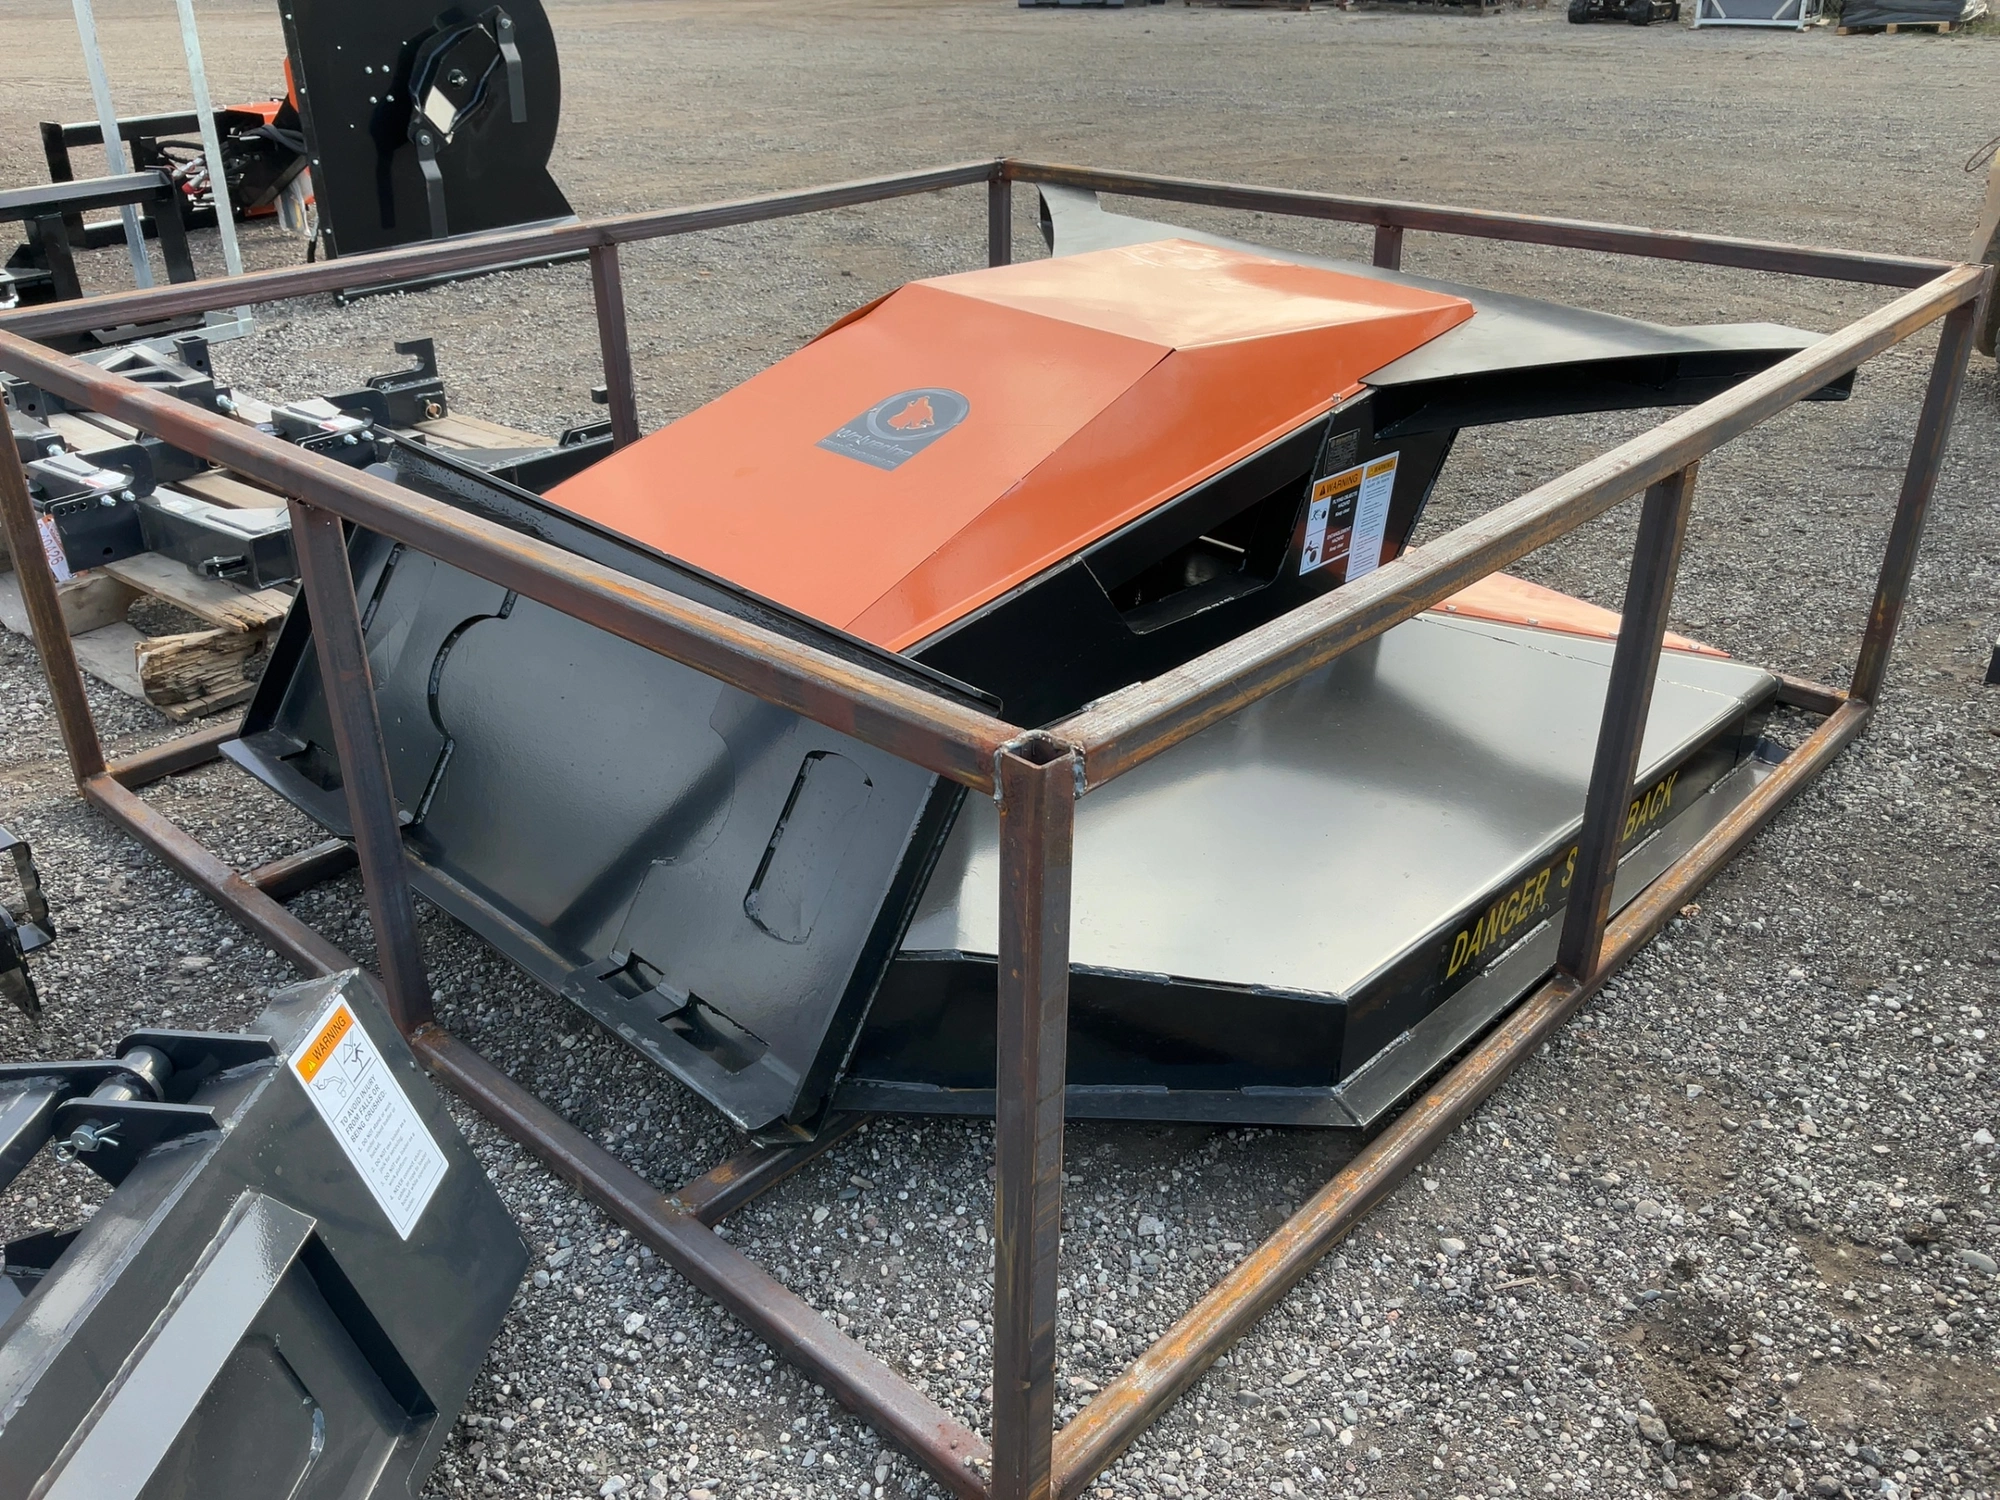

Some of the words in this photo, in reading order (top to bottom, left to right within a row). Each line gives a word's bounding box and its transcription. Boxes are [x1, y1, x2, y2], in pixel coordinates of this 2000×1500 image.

[1326, 473, 1358, 492] WARNING
[1622, 771, 1679, 841] BACK
[1446, 868, 1550, 979] DANGER
[312, 1016, 347, 1061] WARNING
[340, 1116, 349, 1127] TO
[347, 1096, 362, 1119] AVOID
[360, 1074, 376, 1099] INJURY
[345, 1113, 361, 1136] FROM
[359, 1094, 374, 1116] FALLS
[372, 1084, 381, 1096] OR
[350, 1121, 366, 1143] BEING
[365, 1091, 386, 1122] CRUSHED:
